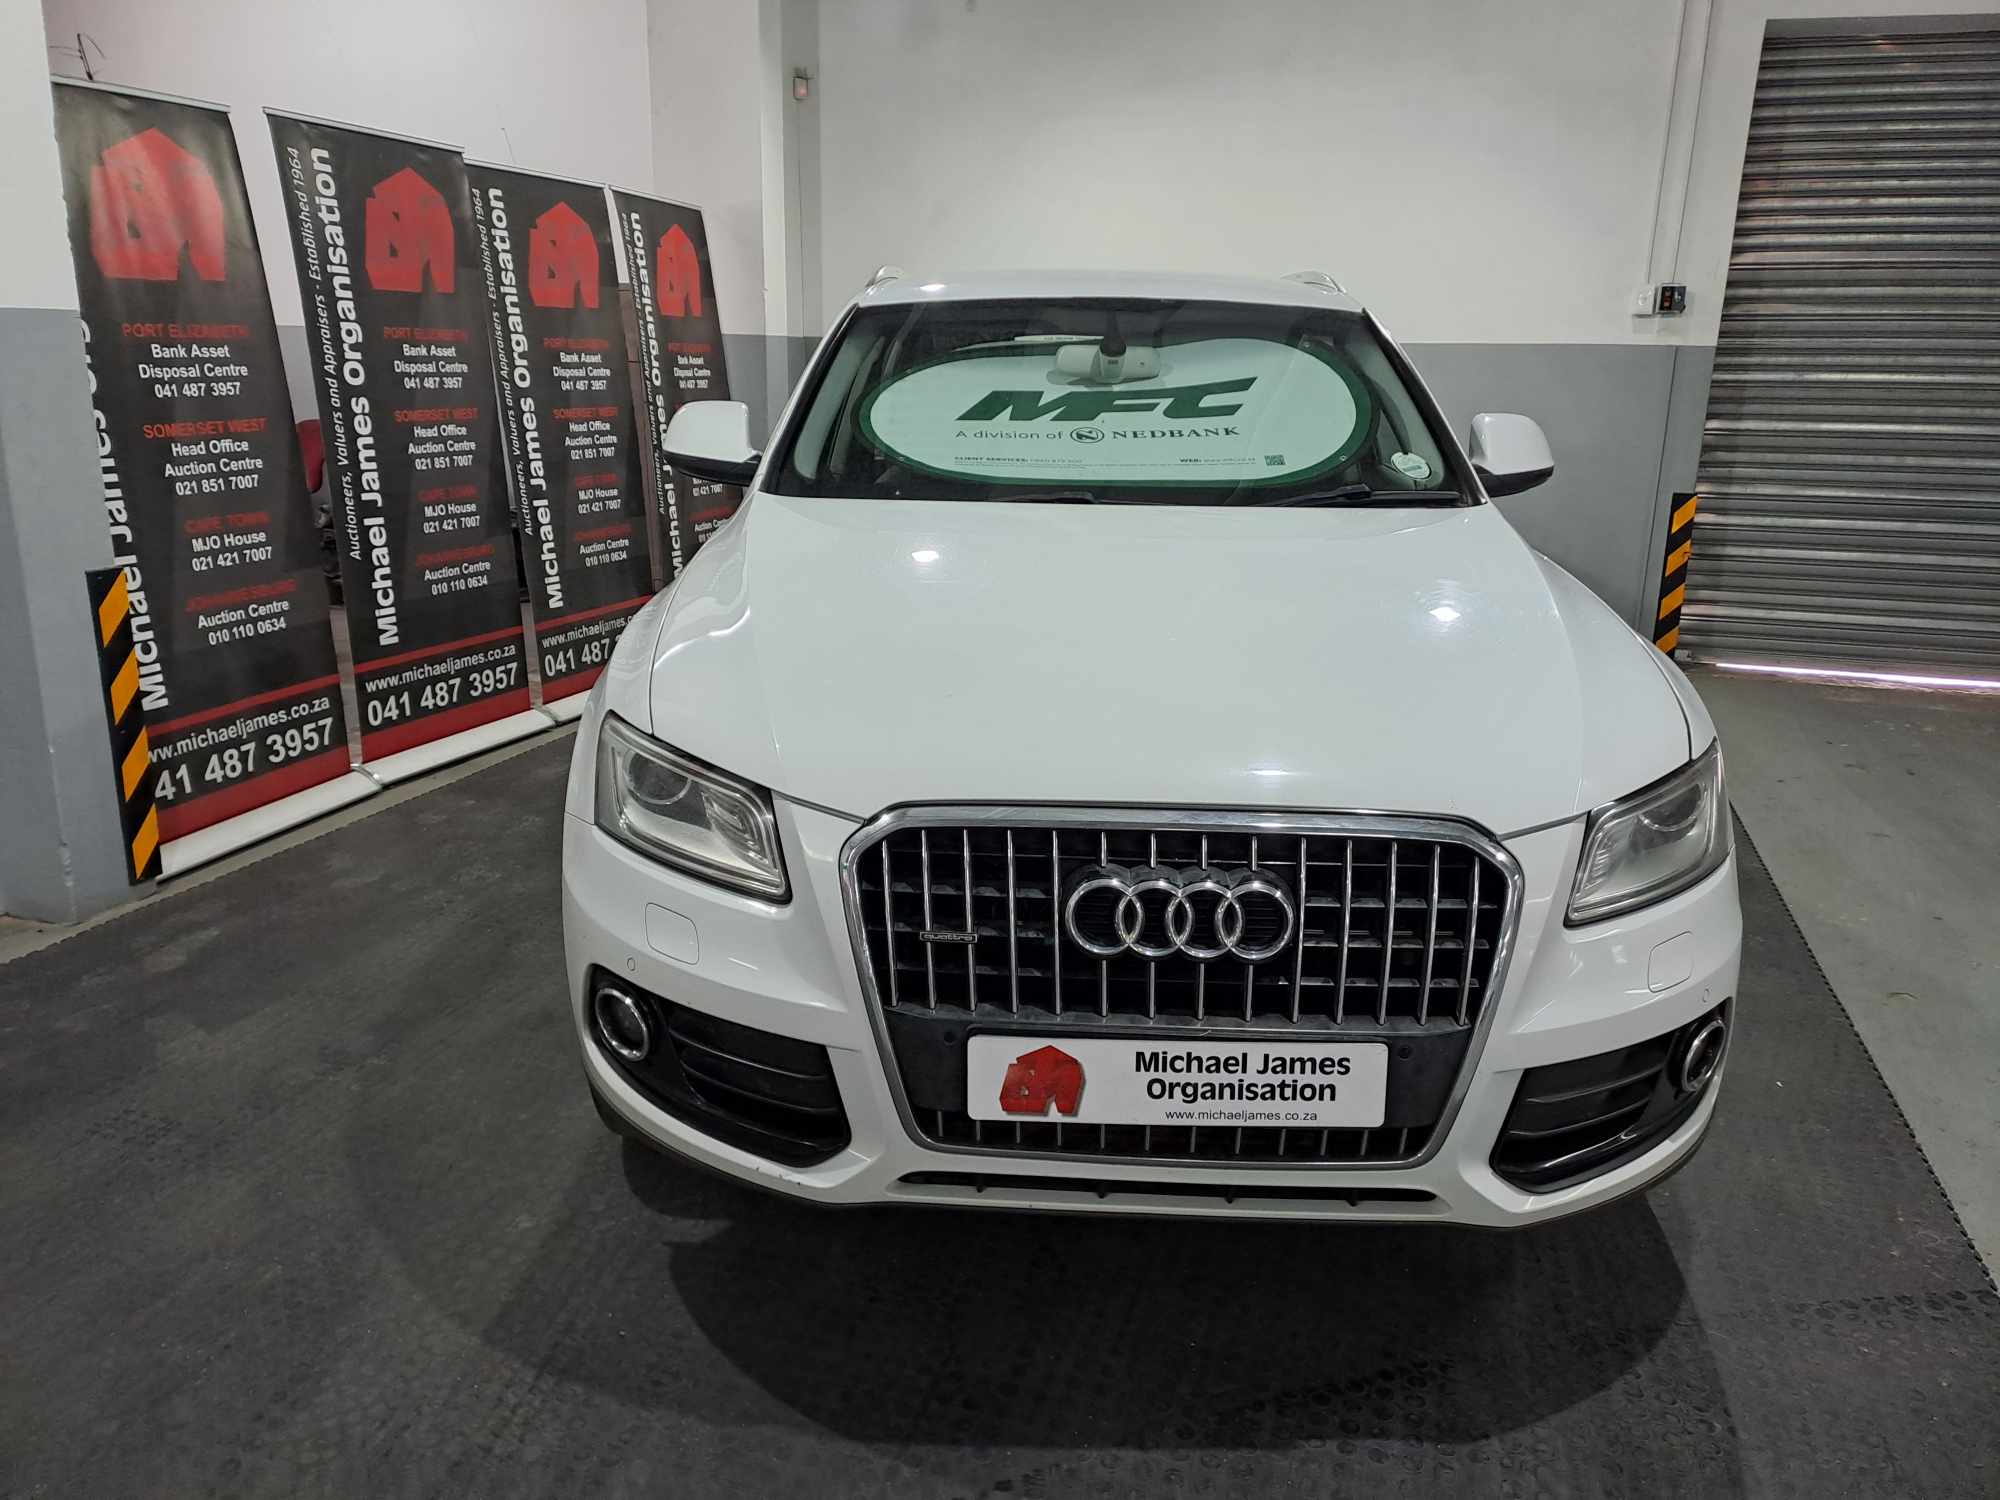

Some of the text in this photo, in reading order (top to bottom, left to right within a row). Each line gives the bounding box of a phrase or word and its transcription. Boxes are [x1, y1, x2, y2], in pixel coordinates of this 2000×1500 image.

[151, 344, 230, 358] Bank Asset
[287, 147, 362, 561] Auctioneers, Valuers and Appraisers Established 1964
[403, 344, 456, 357] Bank Asset
[138, 363, 248, 381] Disposal Centre
[394, 360, 468, 375] Disposal Centre
[155, 382, 241, 398] 041 487 3957
[404, 377, 422, 390] 041
[502, 380, 513, 406] and
[310, 147, 400, 647] Michael James Organisation
[488, 188, 564, 610] Michael James Organisation
[954, 376, 1258, 421] MFC
[143, 416, 268, 439] SOMERSET WEST
[414, 424, 467, 438] Head Office
[507, 409, 521, 456] Valuers
[589, 421, 610, 432] Office
[955, 426, 1240, 440] A division of NEDBANK
[172, 440, 249, 457] Head Office
[408, 440, 476, 455] Auction Centre
[565, 436, 592, 447] Auction
[164, 457, 263, 478] Auction Centre
[415, 455, 473, 470] 021 851 7007
[176, 474, 259, 496] 021 851 7007
[516, 461, 533, 536] Auctioneers,
[424, 503, 477, 518] MJO House
[424, 516, 481, 534] 021 421 7007
[192, 532, 267, 552] MJO House
[580, 544, 606, 555] Auction
[192, 546, 272, 572] 021 421 7007
[424, 560, 491, 581] Auction Centre
[431, 582, 448, 596] 010
[450, 580, 466, 592] 110
[198, 600, 289, 629] Auction Centre
[114, 554, 169, 712] Michael
[208, 617, 287, 646] 010 110 0634
[544, 638, 610, 677] 041 487
[366, 645, 516, 693] www.michaeljames.co.za
[368, 662, 519, 727] 041 487 3957
[204, 742, 257, 784] 487
[266, 717, 334, 763] 3957
[1135, 1051, 1351, 1076] Michael James
[1146, 1078, 1337, 1105] Organisation
[1165, 1110, 1318, 1123] www.michaeljames.co.za
